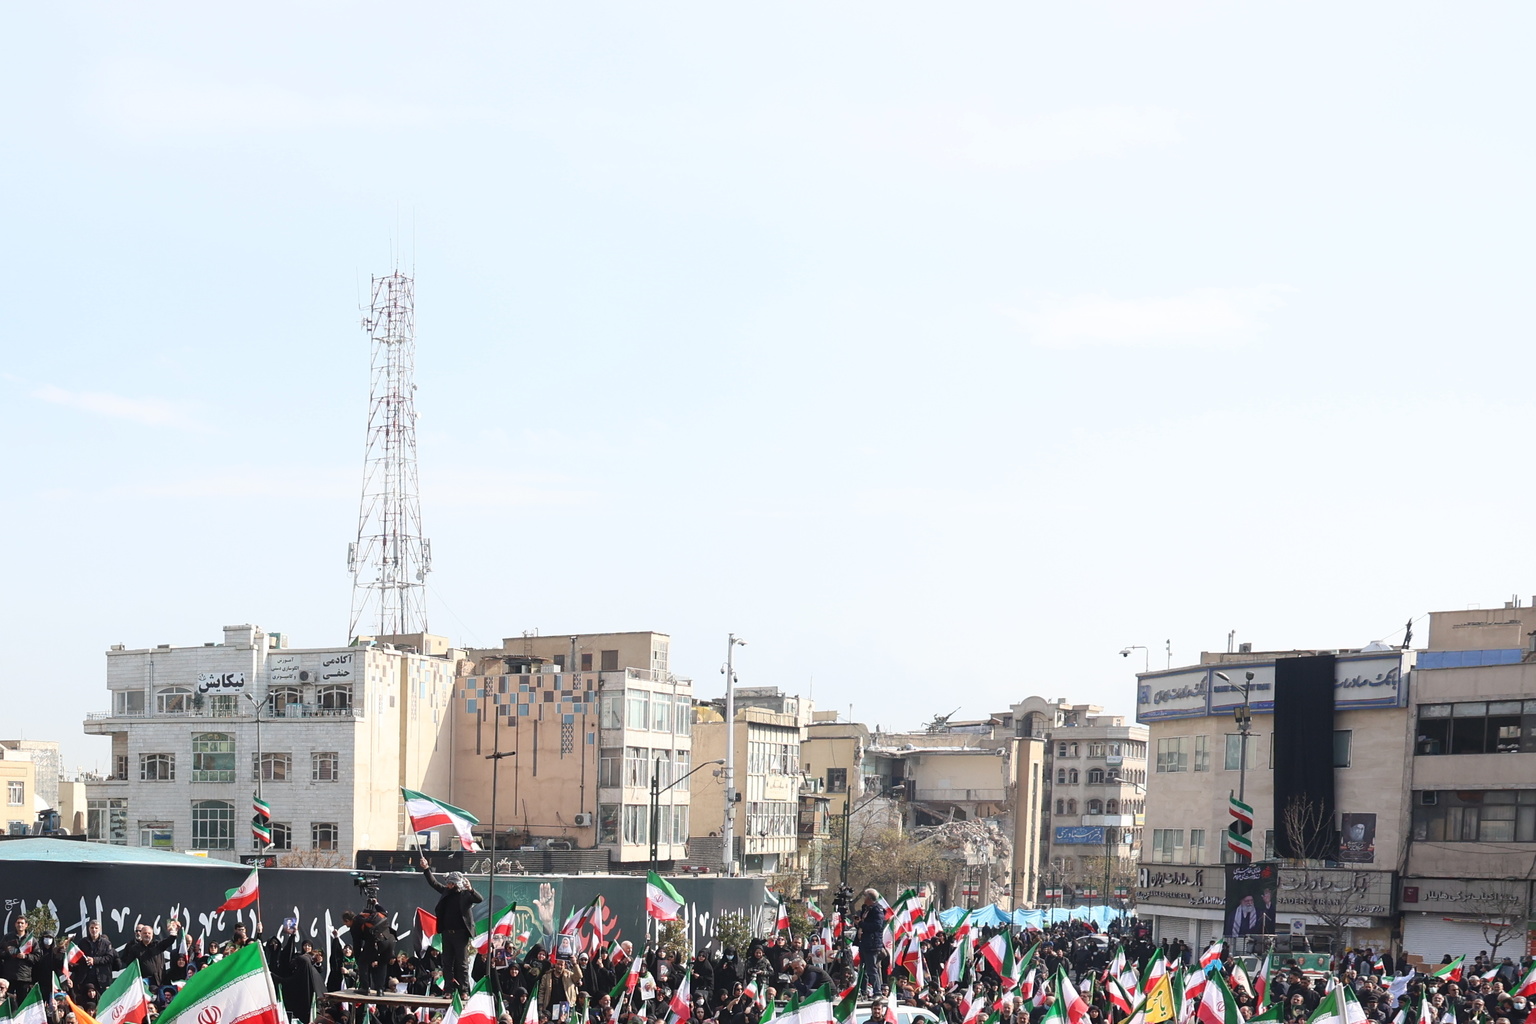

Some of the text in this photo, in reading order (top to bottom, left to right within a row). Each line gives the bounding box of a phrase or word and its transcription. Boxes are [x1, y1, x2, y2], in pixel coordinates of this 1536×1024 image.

[322, 654, 353, 667] آکادمی
[322, 668, 350, 680] حنفی
[198, 673, 245, 693] نیکایش
